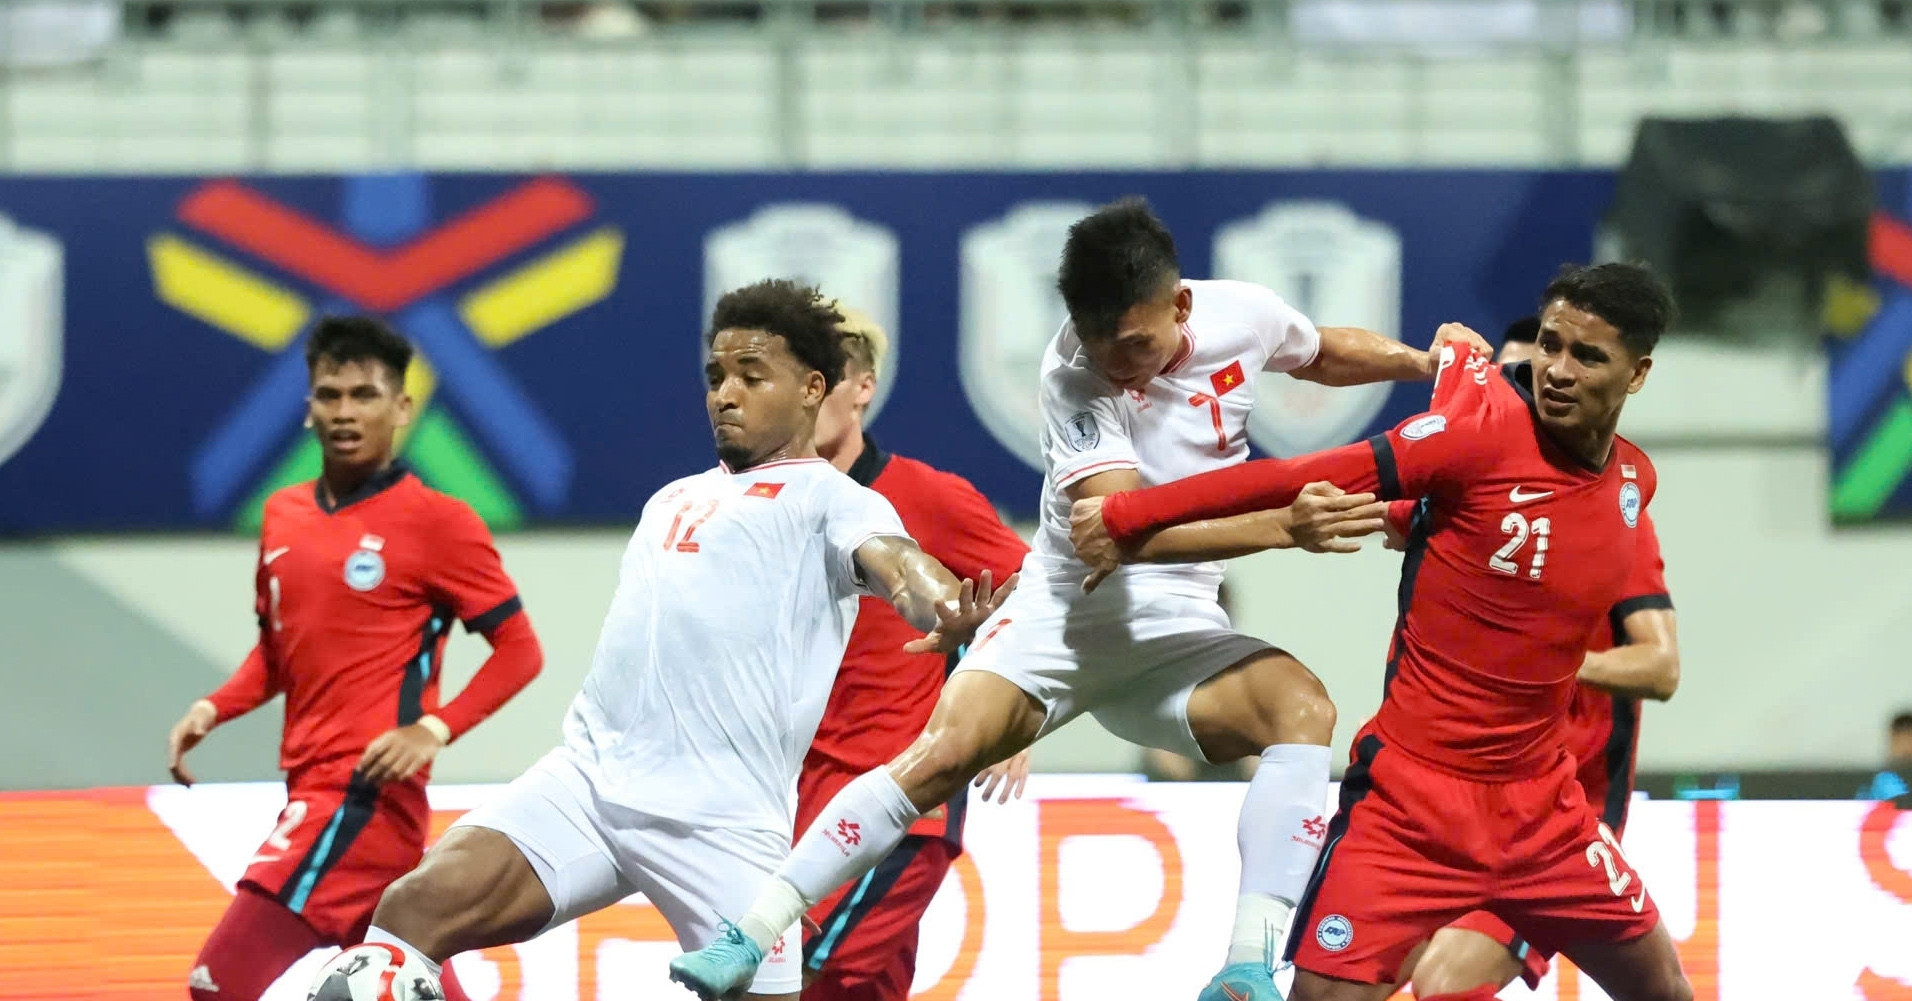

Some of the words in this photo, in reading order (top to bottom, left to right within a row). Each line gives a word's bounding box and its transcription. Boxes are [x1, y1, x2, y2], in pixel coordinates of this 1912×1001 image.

[1188, 391, 1226, 451] 7
[663, 500, 720, 553] 12
[1489, 512, 1551, 579] 21
